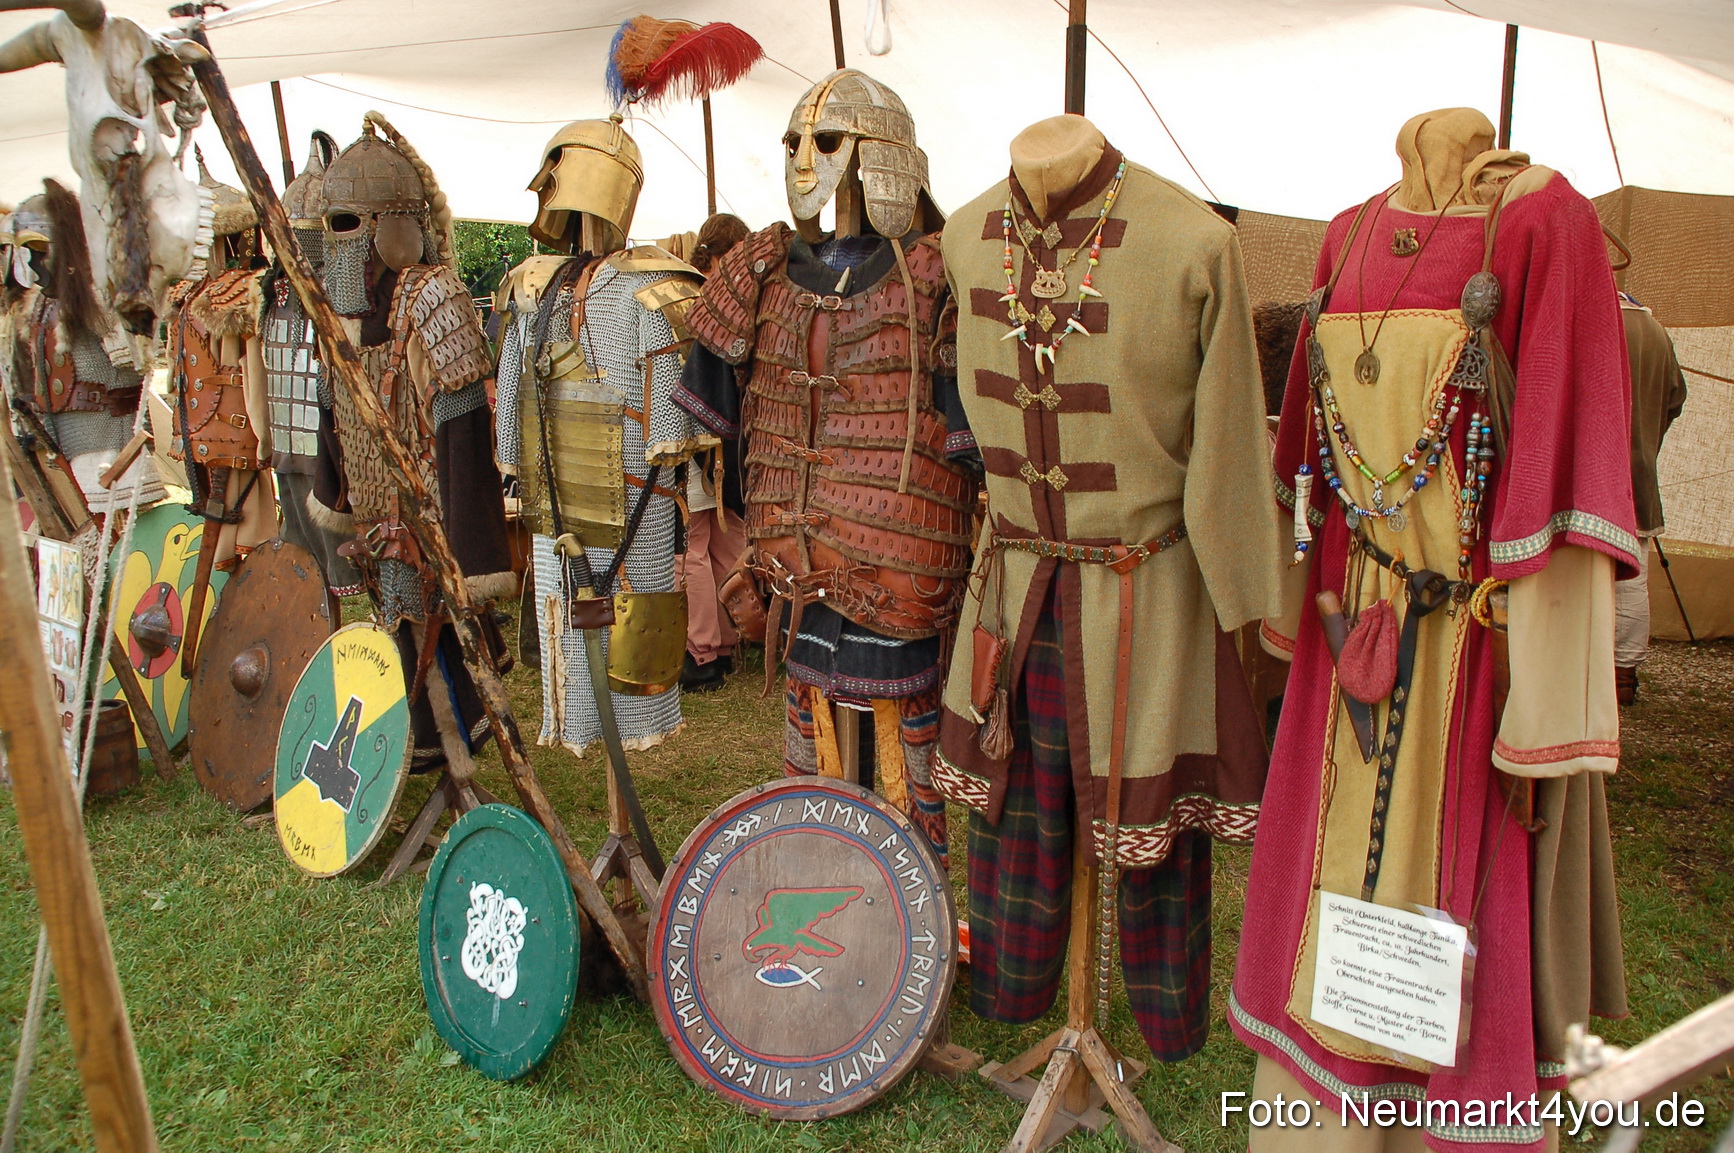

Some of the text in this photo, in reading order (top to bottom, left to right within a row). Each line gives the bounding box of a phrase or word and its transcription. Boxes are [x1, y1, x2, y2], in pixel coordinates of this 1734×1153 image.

[1328, 903, 1353, 915] Schnitt
[1378, 928, 1395, 936] einer
[1397, 933, 1441, 951] schwedischen
[1330, 956, 1446, 997] So koennte eine Frauentracht der
[1336, 969, 1437, 1006] Oberschicht ausgesehen haben.
[1324, 986, 1338, 995] Die
[1339, 990, 1400, 1019] Zusammenstellung
[1402, 1012, 1414, 1020] der
[1346, 1004, 1367, 1016] Garne
[1377, 1015, 1404, 1028] Muster
[1405, 1024, 1418, 1033] der
[1419, 1028, 1446, 1043] Borten
[1354, 1018, 1406, 1041] kommt von uns.
